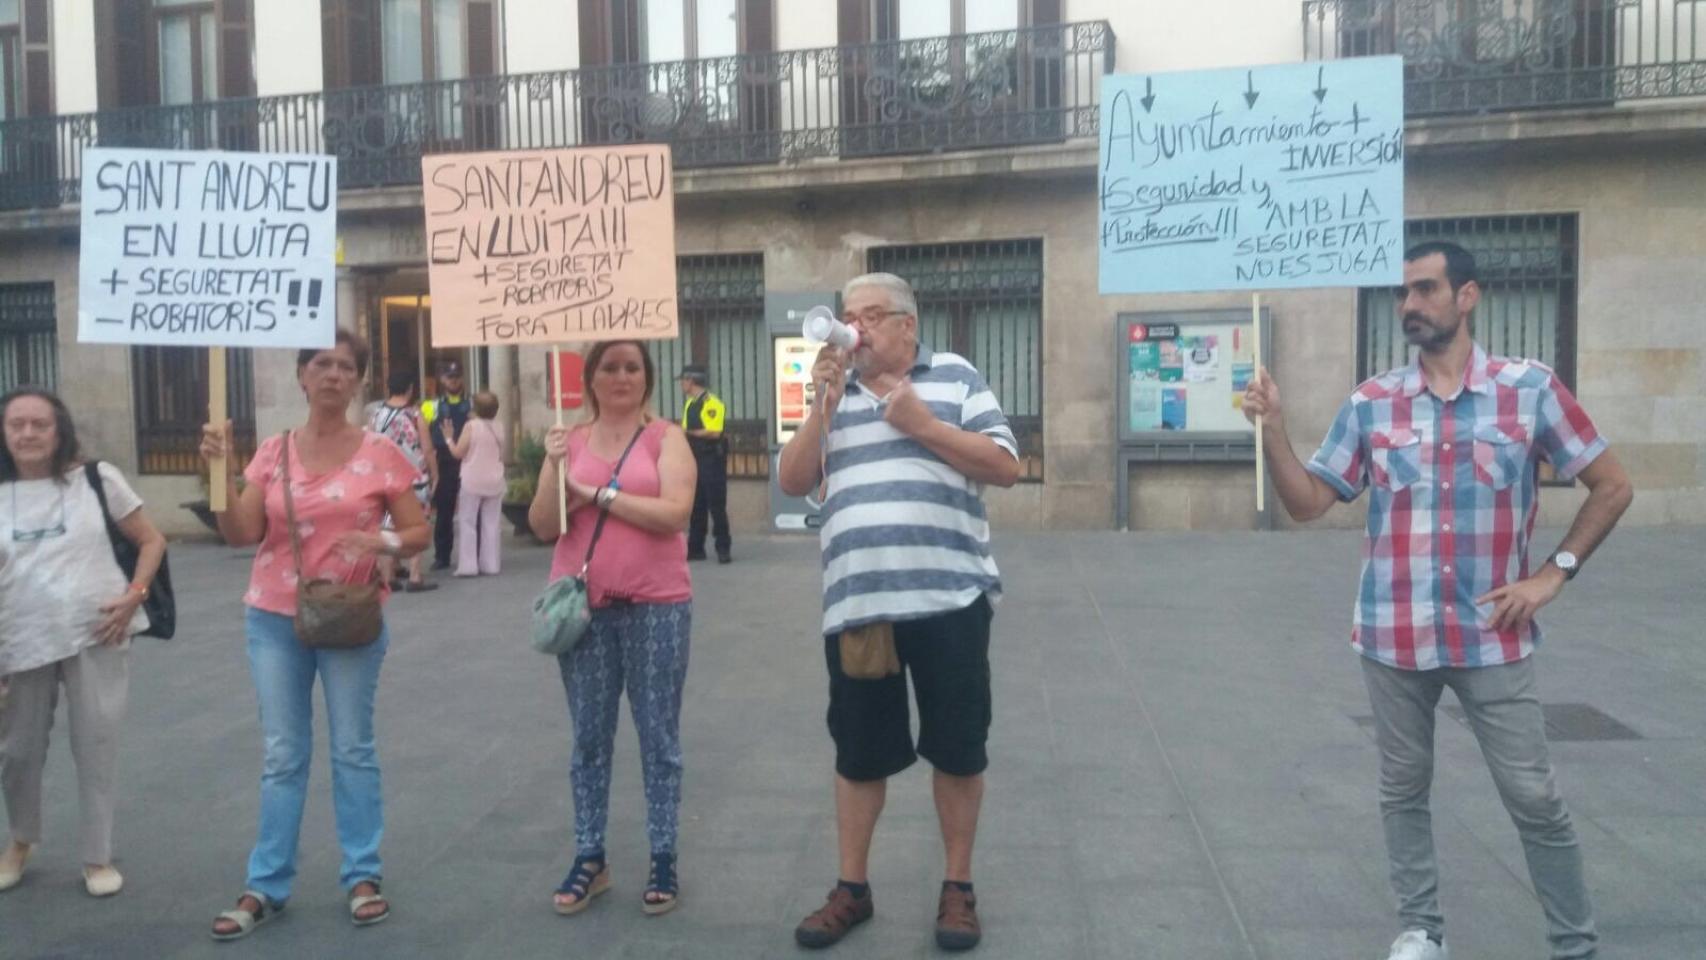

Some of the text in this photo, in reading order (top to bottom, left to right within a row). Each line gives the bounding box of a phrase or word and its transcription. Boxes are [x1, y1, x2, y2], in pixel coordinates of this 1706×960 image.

[93, 159, 330, 215] SANT ANDREU
[1341, 188, 1381, 220] LA
[123, 217, 310, 260] EN LLUITA
[431, 221, 482, 265] EN
[135, 268, 296, 296] SEGURETAT
[1236, 257, 1274, 282] NO
[1278, 253, 1312, 279] ES
[130, 299, 277, 333] ROBATORIS
[476, 297, 674, 342] FORA LLADRES
